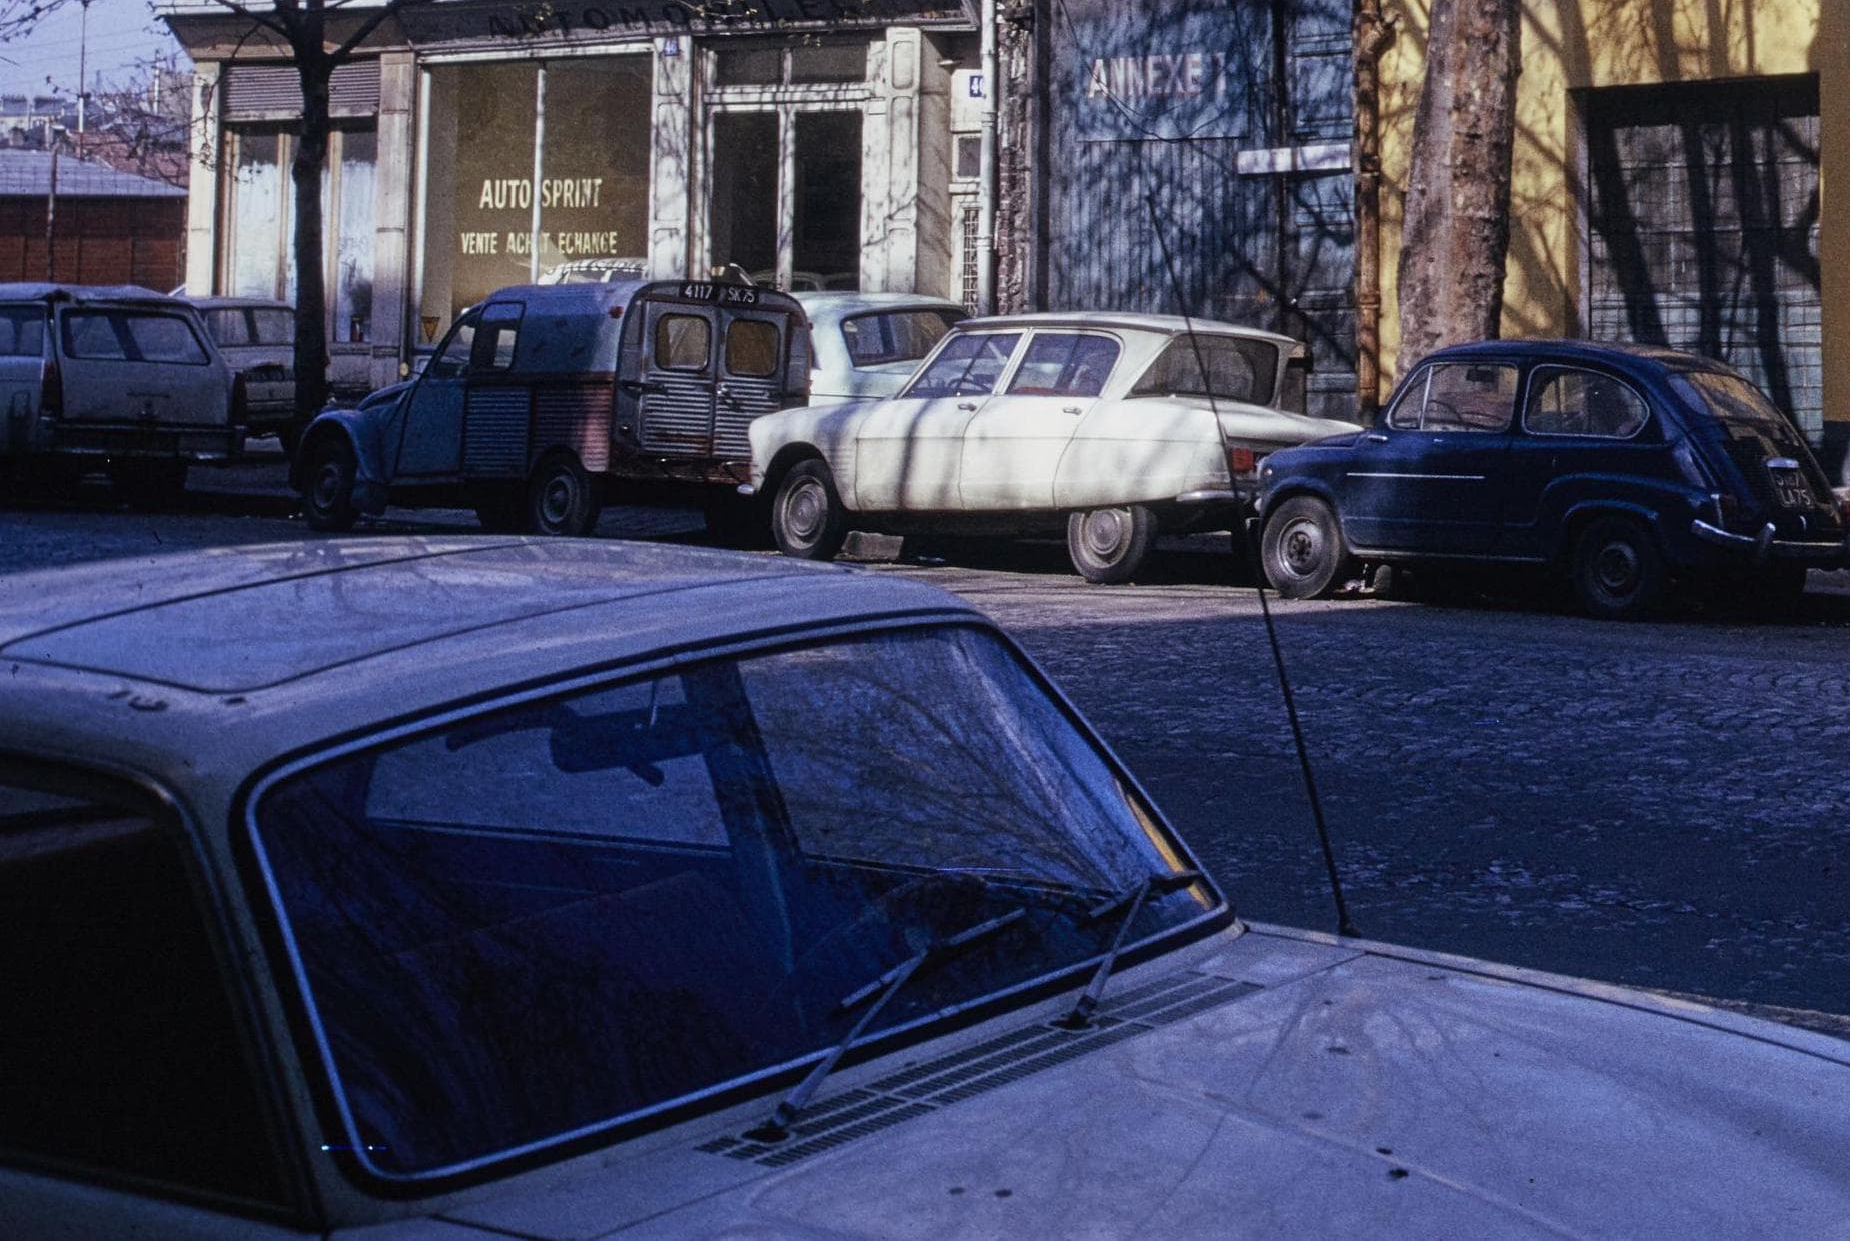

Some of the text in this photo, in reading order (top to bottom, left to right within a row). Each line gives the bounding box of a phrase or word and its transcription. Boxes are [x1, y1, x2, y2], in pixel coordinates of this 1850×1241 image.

[479, 177, 603, 209] AUTO SPRINT
[461, 230, 619, 255] VENTE ACHT ECHANGE
[685, 284, 713, 299] 4117
